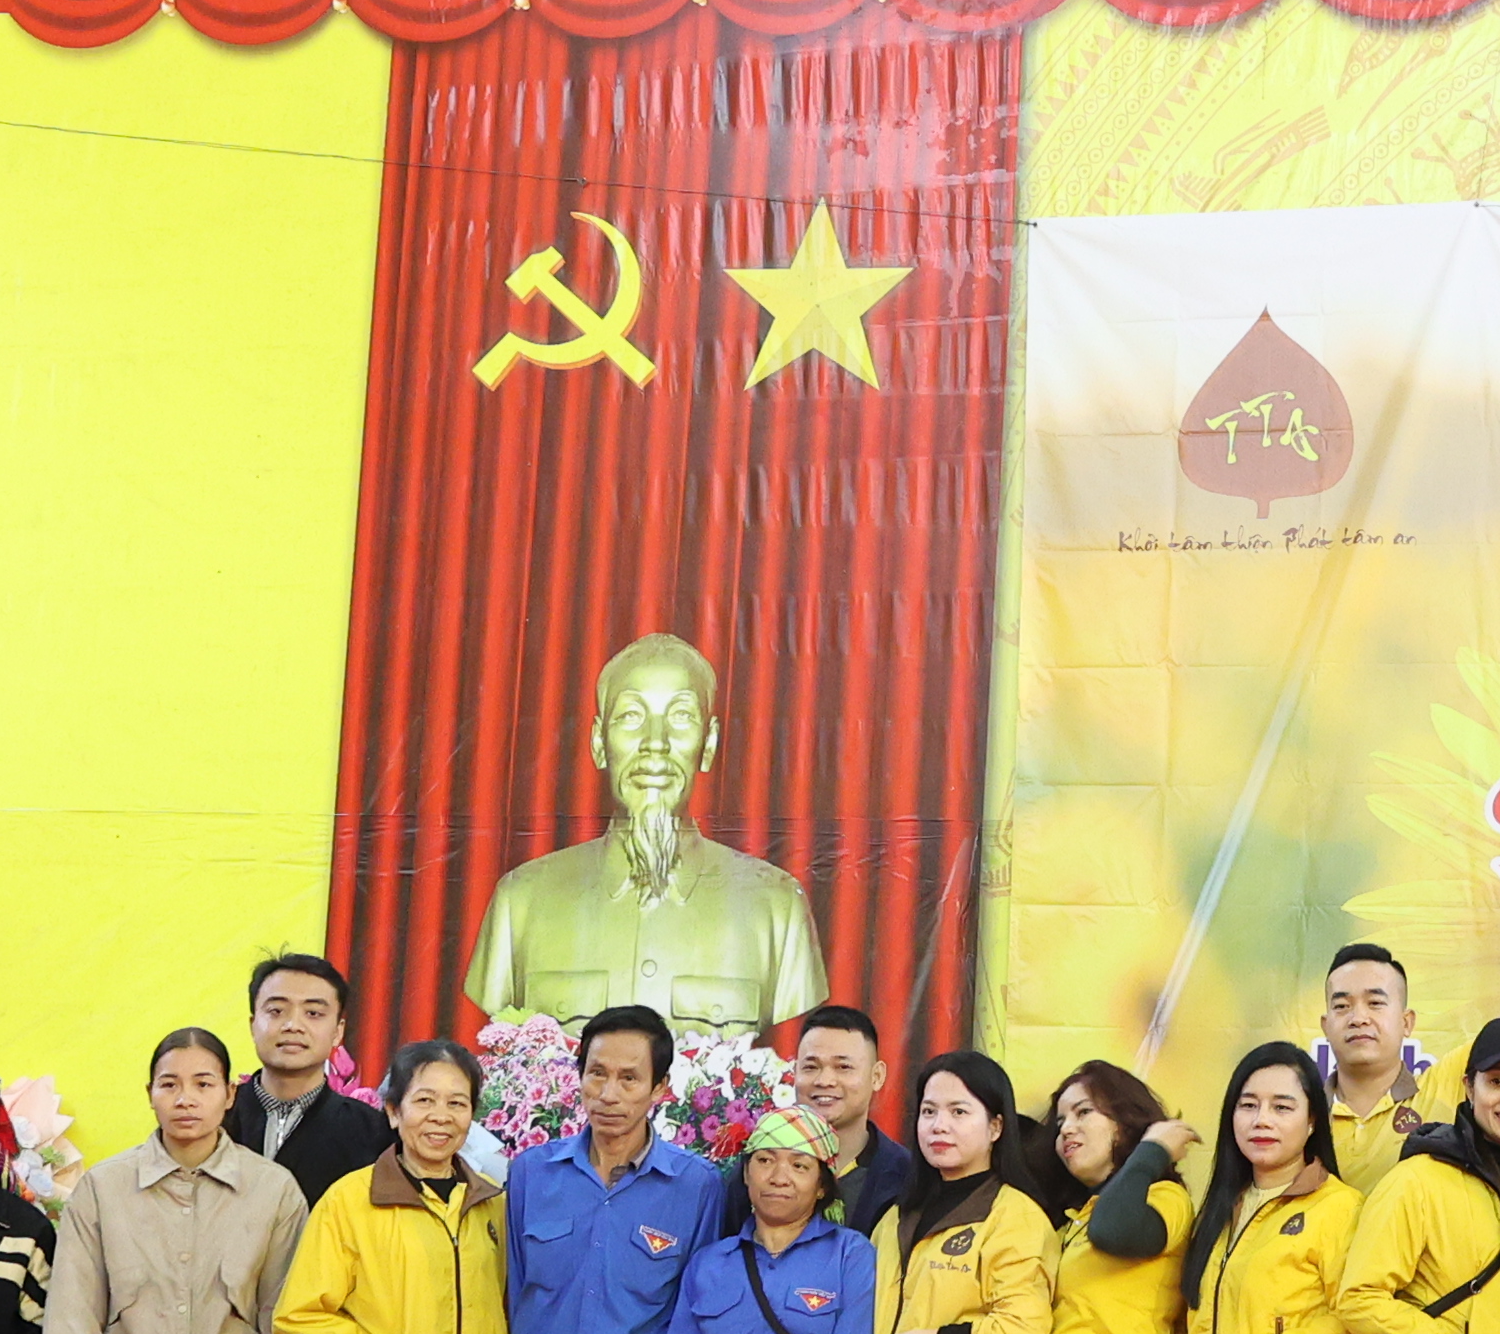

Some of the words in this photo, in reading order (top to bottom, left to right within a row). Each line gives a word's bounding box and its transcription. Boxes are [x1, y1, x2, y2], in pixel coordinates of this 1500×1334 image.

[1168, 532, 1212, 552] tâm
[1221, 525, 1273, 553] thiện
[1341, 527, 1383, 545] tâm
[1393, 532, 1417, 546] an
